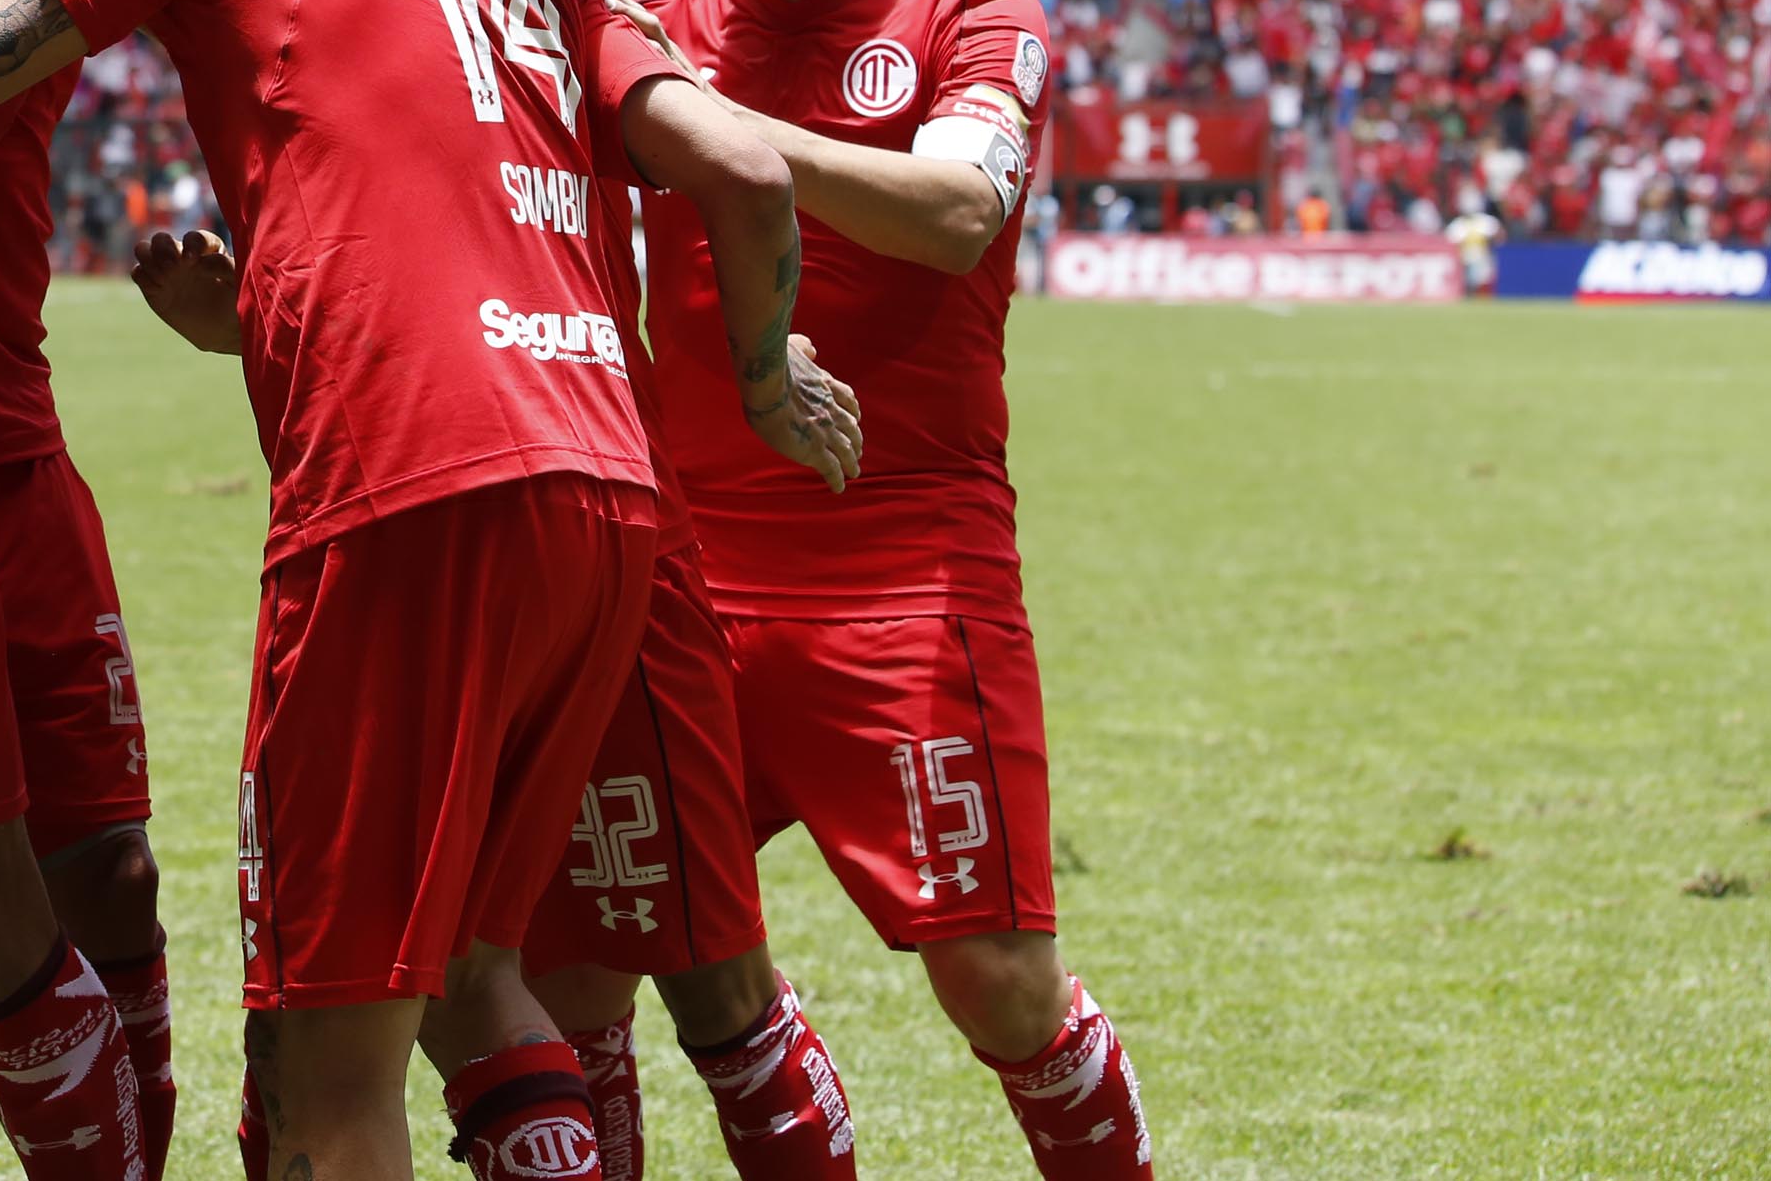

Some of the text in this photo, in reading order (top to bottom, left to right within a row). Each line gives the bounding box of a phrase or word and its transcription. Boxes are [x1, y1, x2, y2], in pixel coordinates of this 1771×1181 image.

[1051, 238, 1453, 298] Office DEPOT
[889, 736, 989, 858] 15
